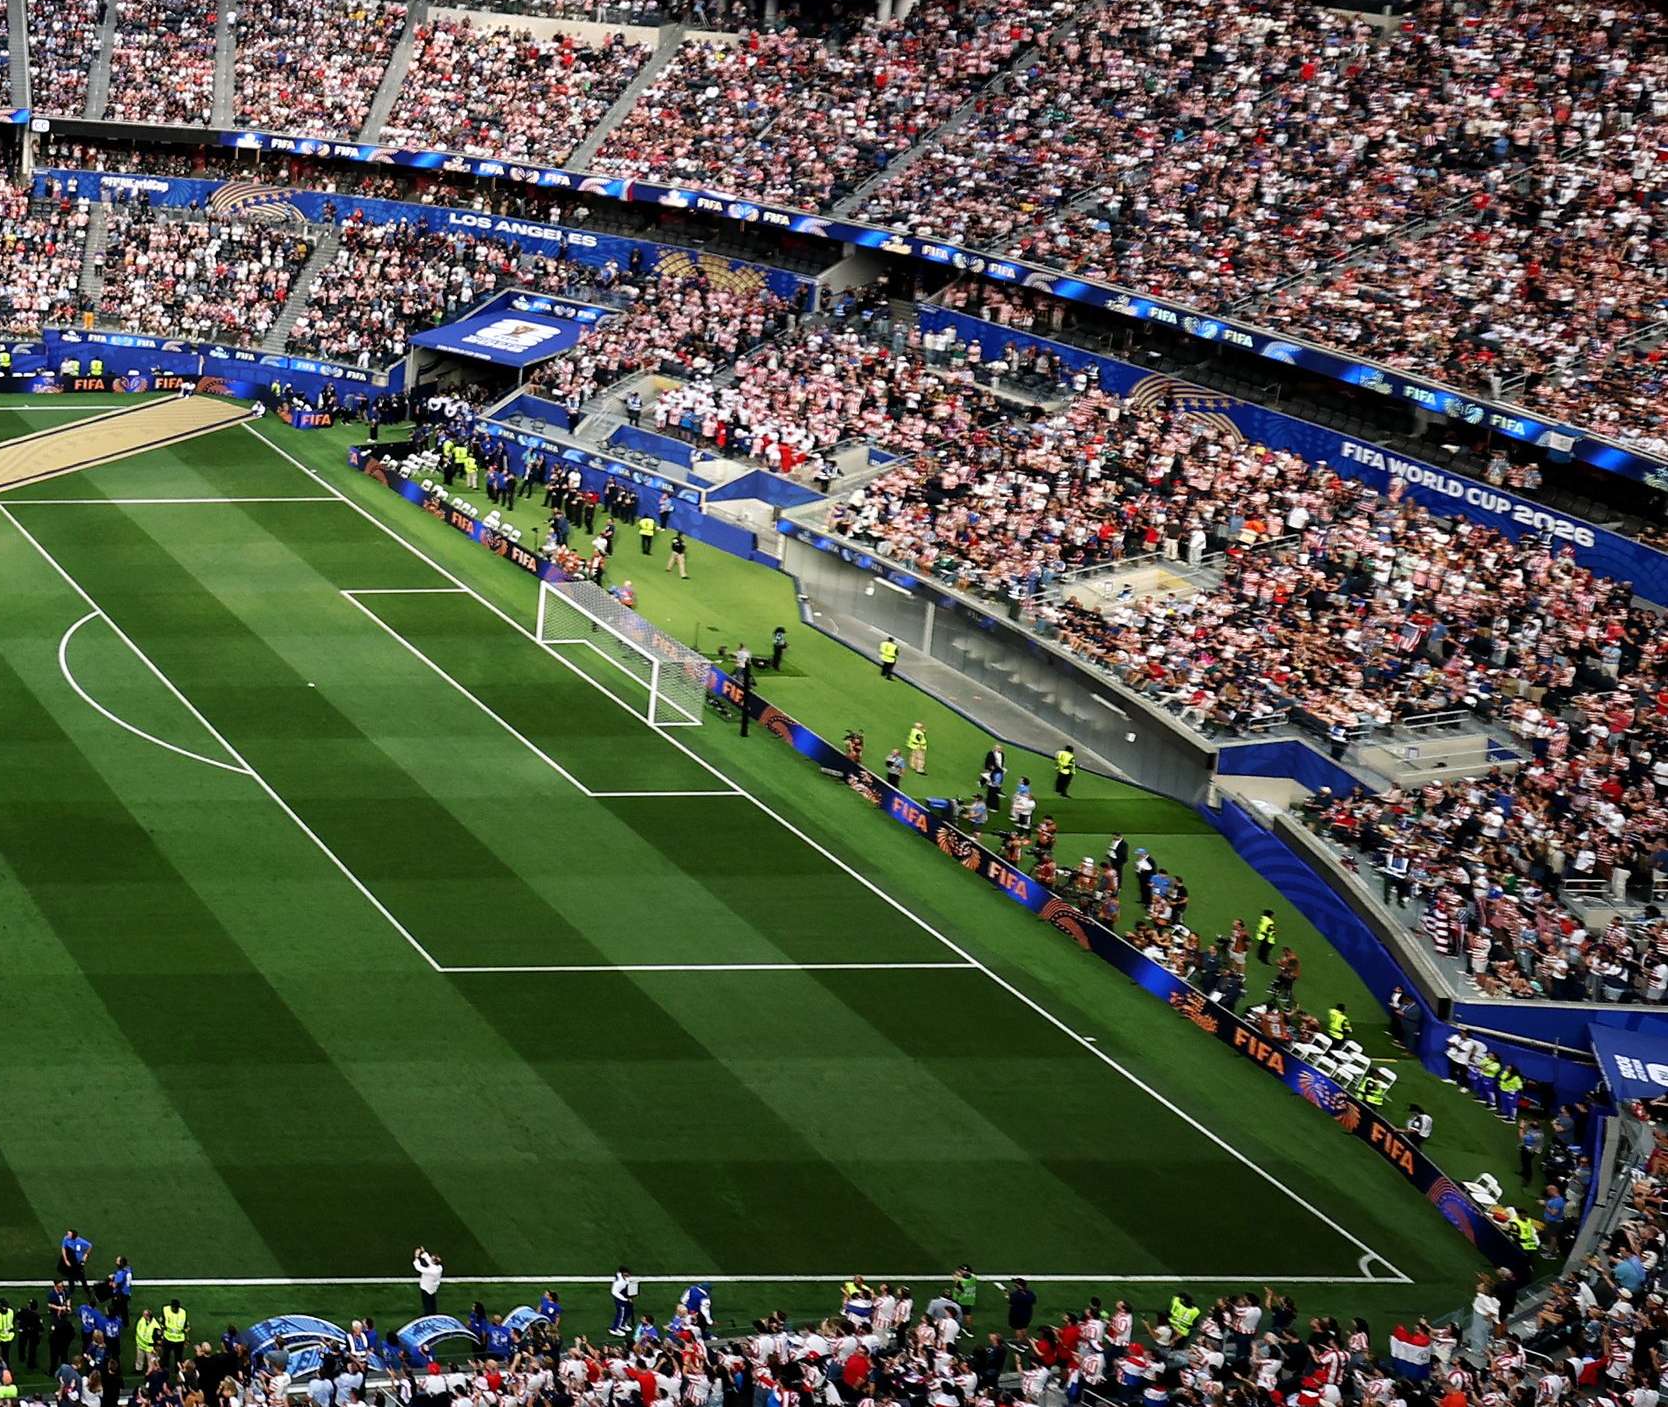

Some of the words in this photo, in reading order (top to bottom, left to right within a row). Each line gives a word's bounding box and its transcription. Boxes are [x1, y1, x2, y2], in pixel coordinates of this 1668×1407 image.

[271, 138, 295, 149] FIFA
[334, 145, 359, 157] FIFA
[480, 164, 504, 176] FIFA
[545, 174, 570, 186] FIFA
[697, 197, 722, 211] FIFA
[763, 212, 790, 226] FIFA
[449, 212, 497, 231] LOS
[499, 220, 597, 247] ANGELES
[921, 244, 948, 260] FIFA
[988, 262, 1015, 279] FIFA
[1148, 307, 1177, 324] FIFA
[1223, 330, 1253, 348] FIFA
[235, 350, 254, 360] FIFA
[74, 378, 104, 390] FIFA
[155, 377, 183, 389] FIFA
[1403, 386, 1435, 405] FIFA
[301, 414, 331, 426] FIFA
[1489, 414, 1524, 435] FIFA
[1341, 441, 1385, 471] FIFA
[1388, 457, 1464, 498] WORLD
[1467, 483, 1511, 514] CUP
[1513, 503, 1595, 548] 2026
[451, 511, 474, 535] FIFA
[512, 544, 536, 572] FIFA
[722, 680, 747, 706] FIF
[892, 796, 928, 833] FIFA
[988, 860, 1028, 900] FIFA
[1233, 1027, 1286, 1076] FIFA
[1370, 1121, 1415, 1175] FIFA
